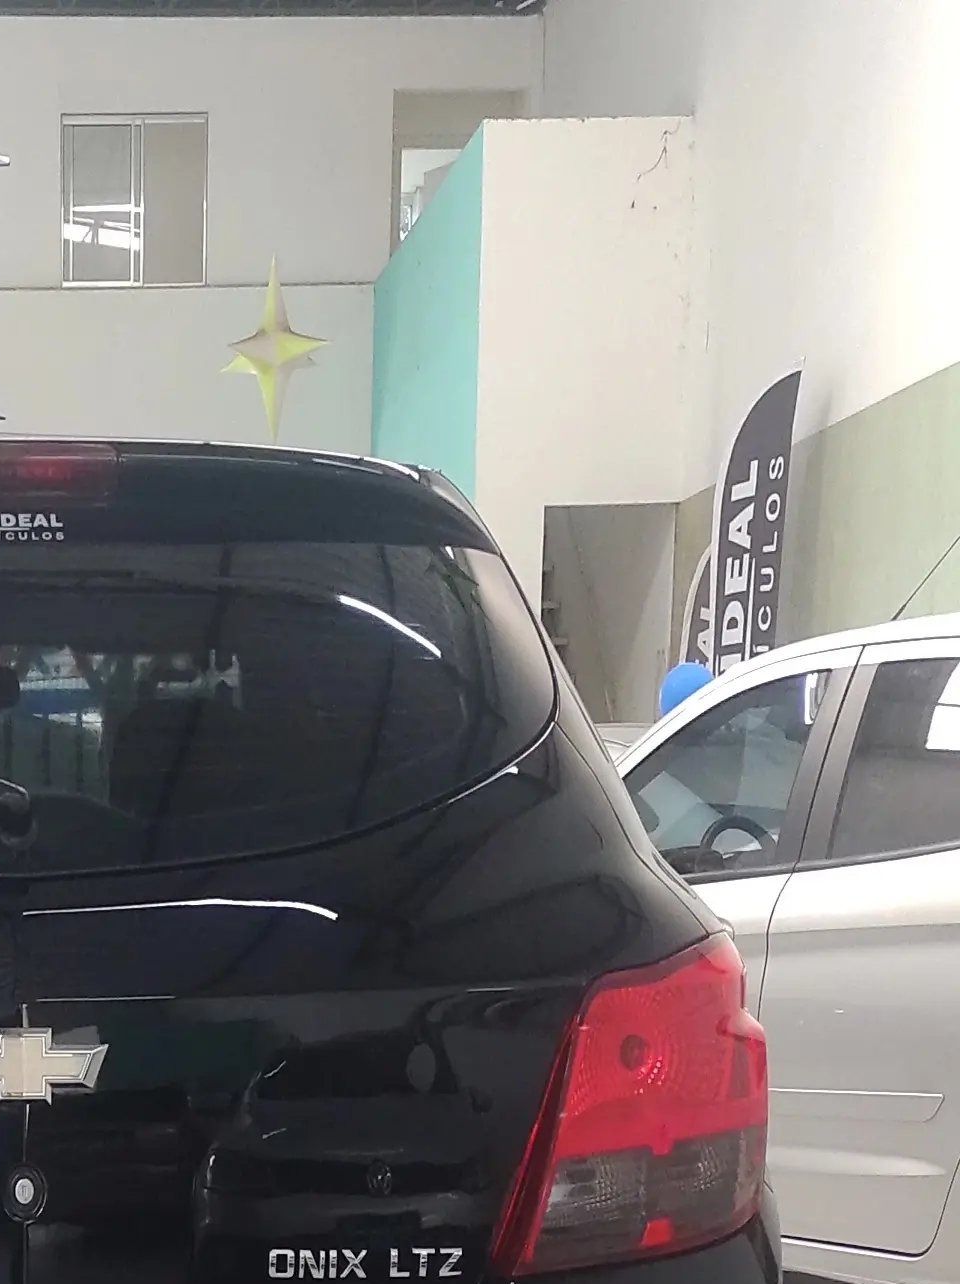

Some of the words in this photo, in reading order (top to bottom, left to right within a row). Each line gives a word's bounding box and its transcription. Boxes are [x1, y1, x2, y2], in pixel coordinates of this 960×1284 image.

[753, 455, 785, 655] ÍCULOS
[268, 1248, 368, 1280] ONIX
[389, 1247, 464, 1279] LTZ
